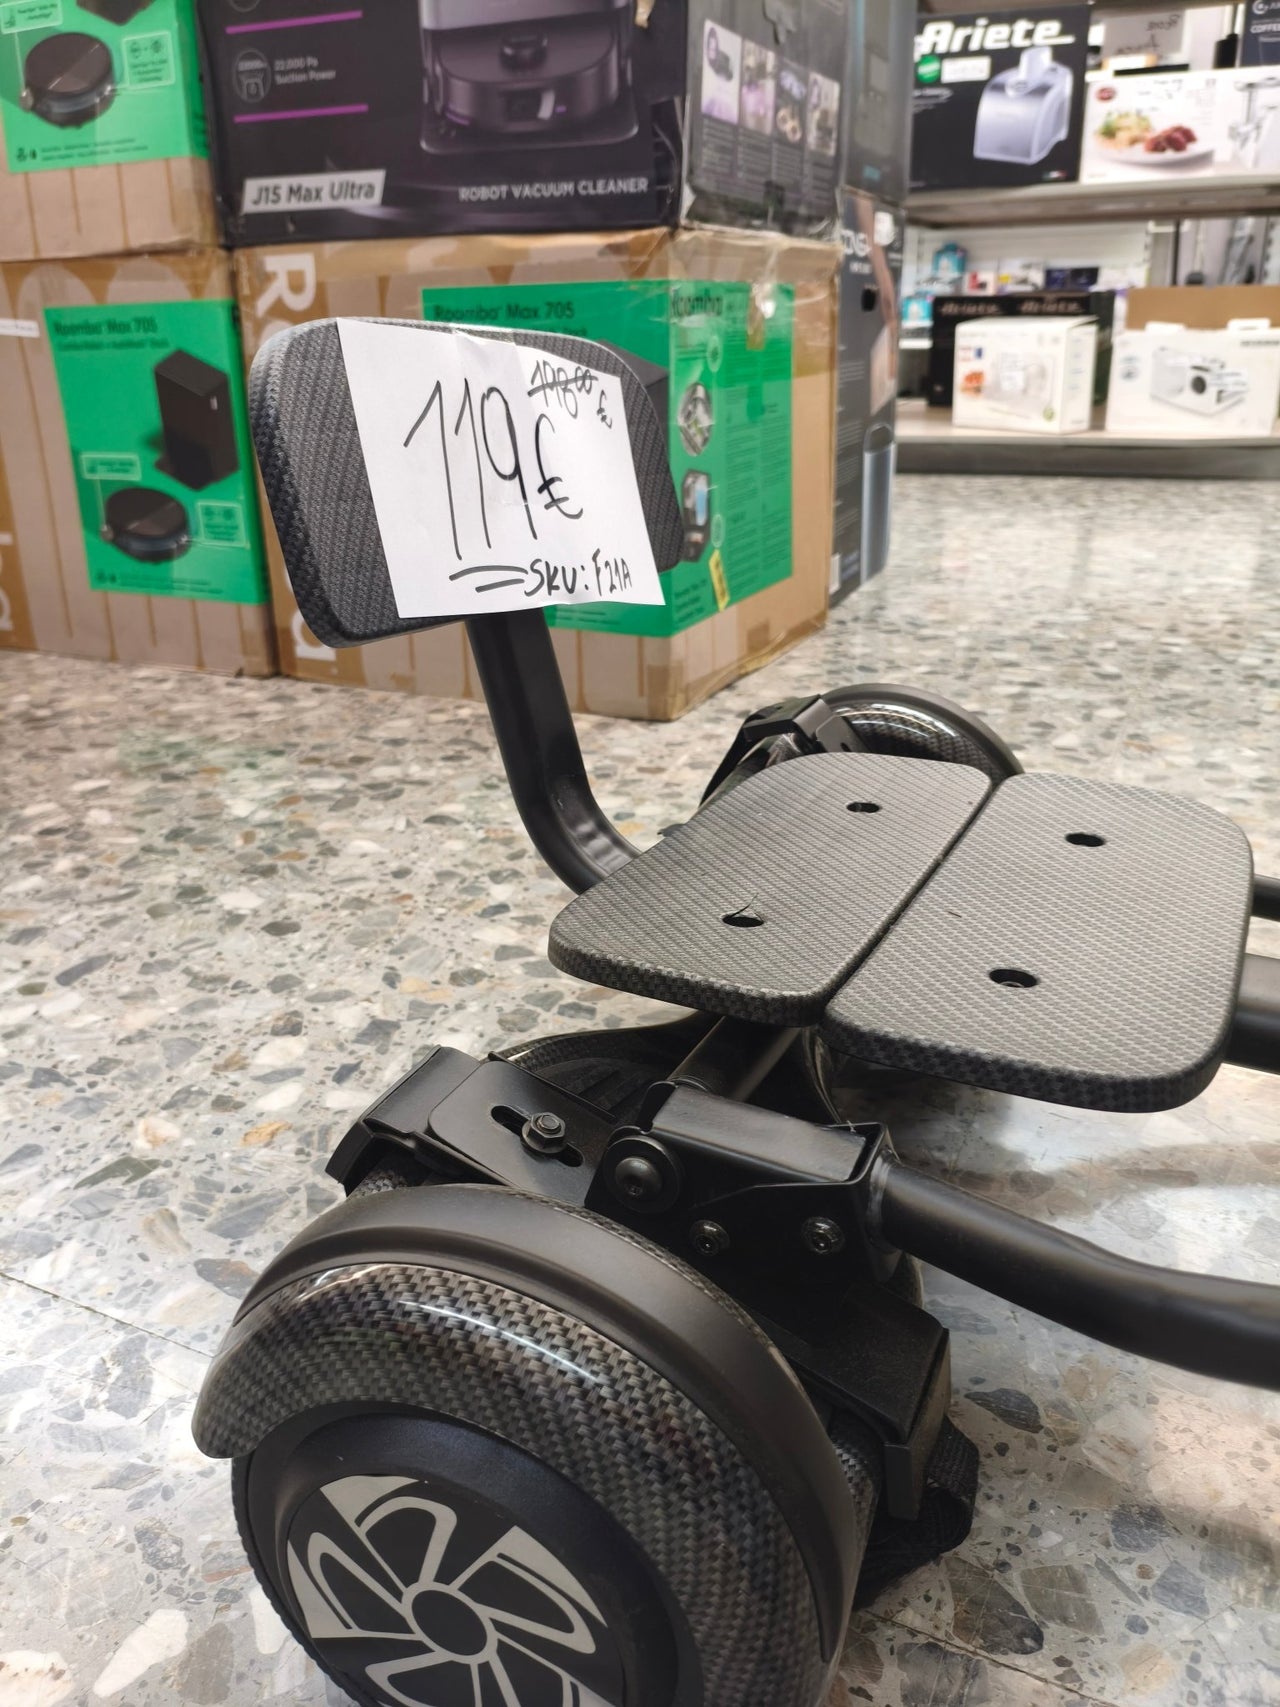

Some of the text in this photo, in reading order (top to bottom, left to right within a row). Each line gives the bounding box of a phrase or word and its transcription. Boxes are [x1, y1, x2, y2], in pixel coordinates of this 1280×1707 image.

[914, 17, 1076, 61] Ariete
[309, 70, 336, 81] Power
[252, 180, 375, 205] J15 Max Ultra
[458, 178, 648, 201] ROBOT VACUUM CLEANER
[506, 303, 540, 320] Max
[545, 301, 575, 319] 705
